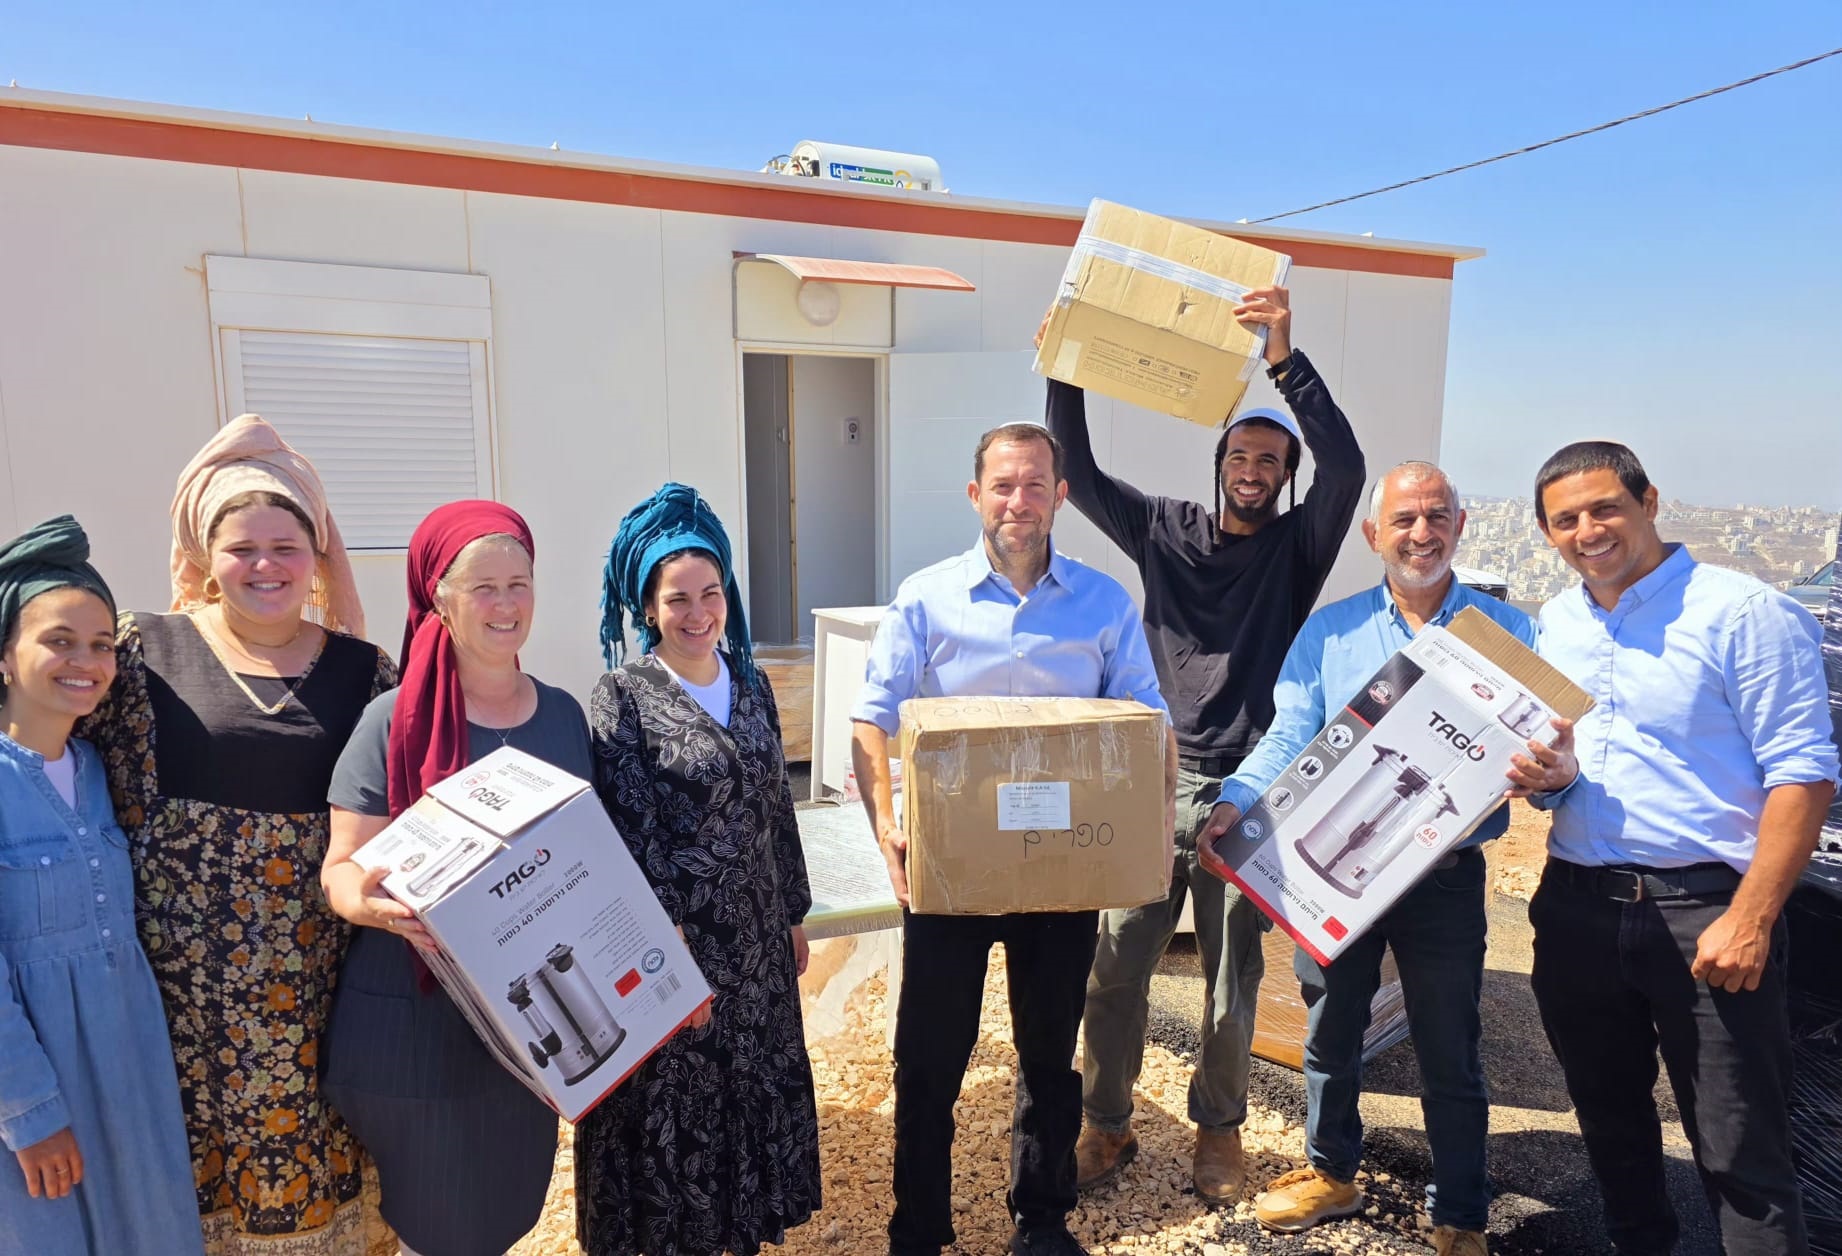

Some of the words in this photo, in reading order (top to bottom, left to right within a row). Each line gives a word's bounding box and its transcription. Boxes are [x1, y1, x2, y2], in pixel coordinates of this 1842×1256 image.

[1428, 710, 1486, 762] TAGO
[468, 787, 511, 812] TAGO
[1023, 822, 1114, 860] ספרים
[1422, 827, 1438, 842] 60
[488, 848, 551, 899] TAGO
[1252, 859, 1270, 877] כוסות
[565, 870, 590, 891] מייחם
[1268, 875, 1279, 885] 60
[534, 888, 566, 917] נירוסטה
[1277, 882, 1301, 904] נירוסטה
[517, 897, 537, 915] Water
[521, 913, 534, 926] 40
[497, 924, 521, 947] כוסות
